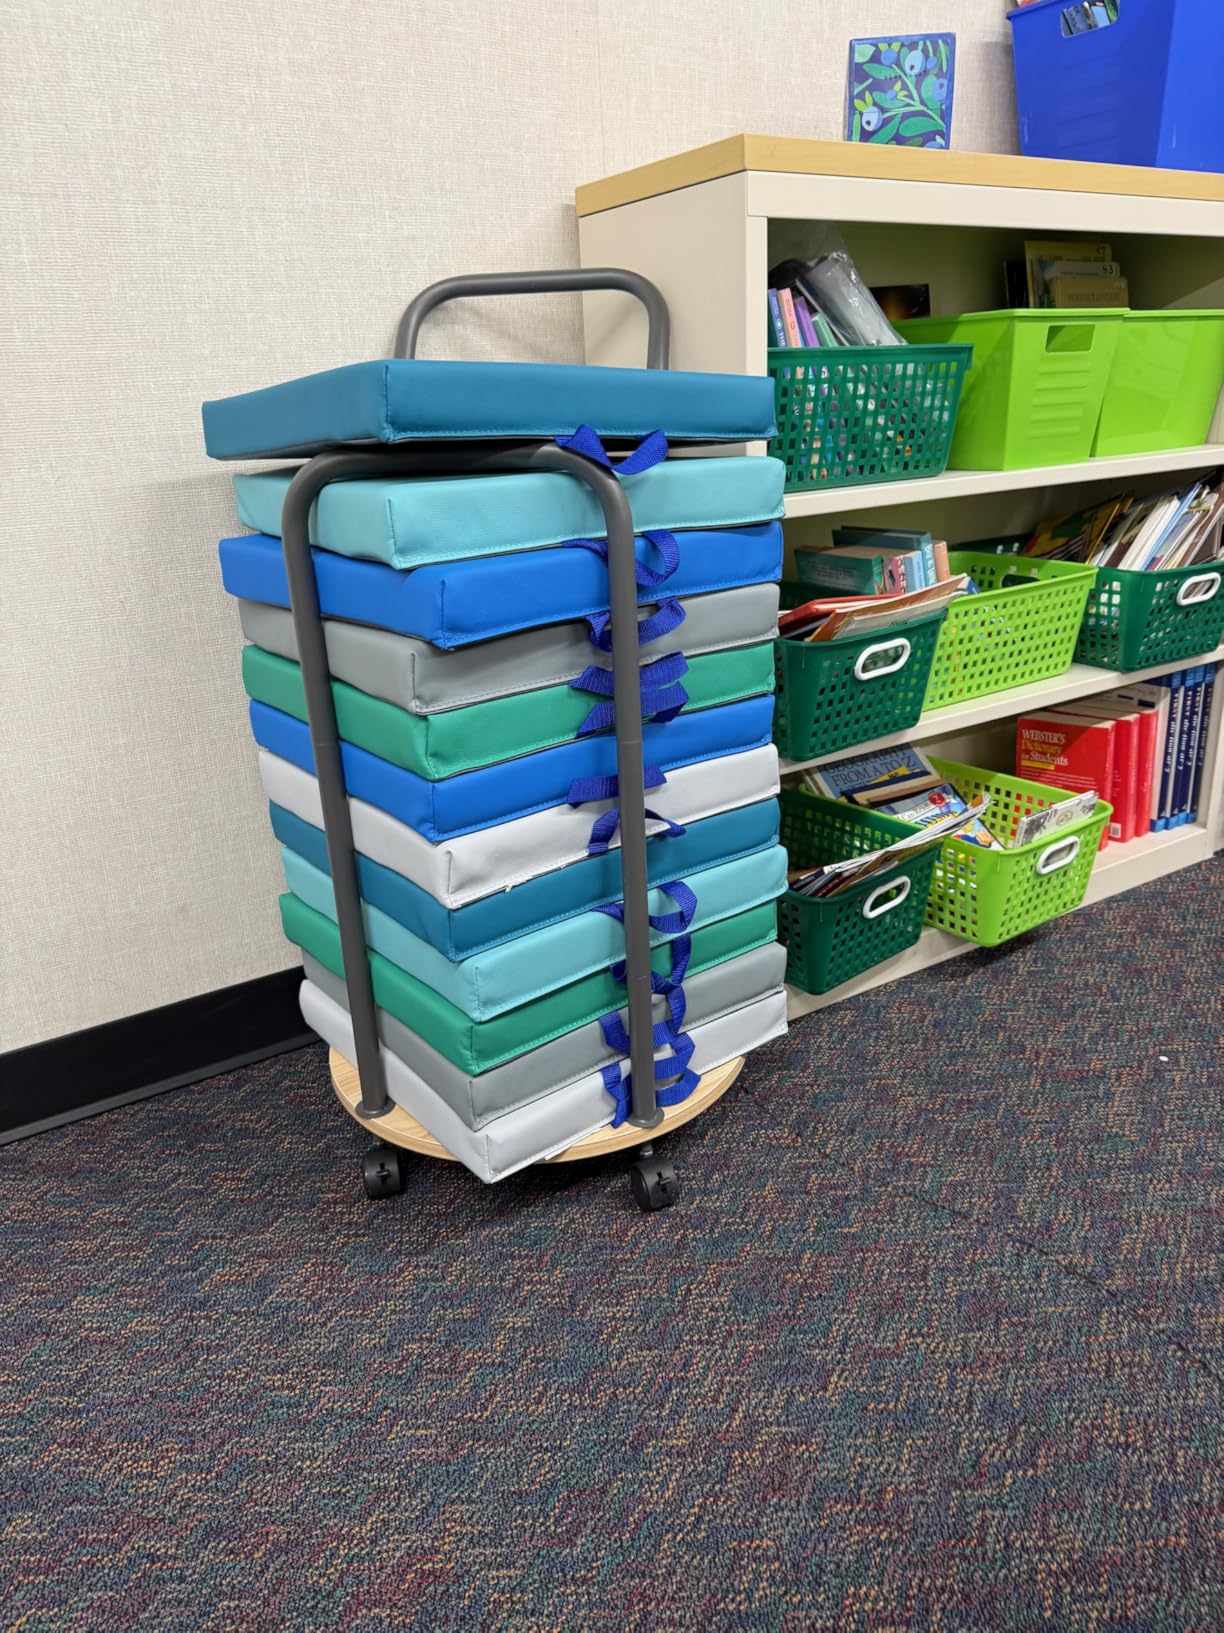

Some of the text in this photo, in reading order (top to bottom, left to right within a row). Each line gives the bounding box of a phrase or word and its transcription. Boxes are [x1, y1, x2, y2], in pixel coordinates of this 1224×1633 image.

[1021, 729, 1066, 745] WEBSTER'S
[1021, 740, 1062, 755] Dictionary
[1030, 751, 1069, 767] Students
[831, 767, 872, 787] FROM
[880, 759, 901, 774] TO
[902, 755, 917, 769] Z
